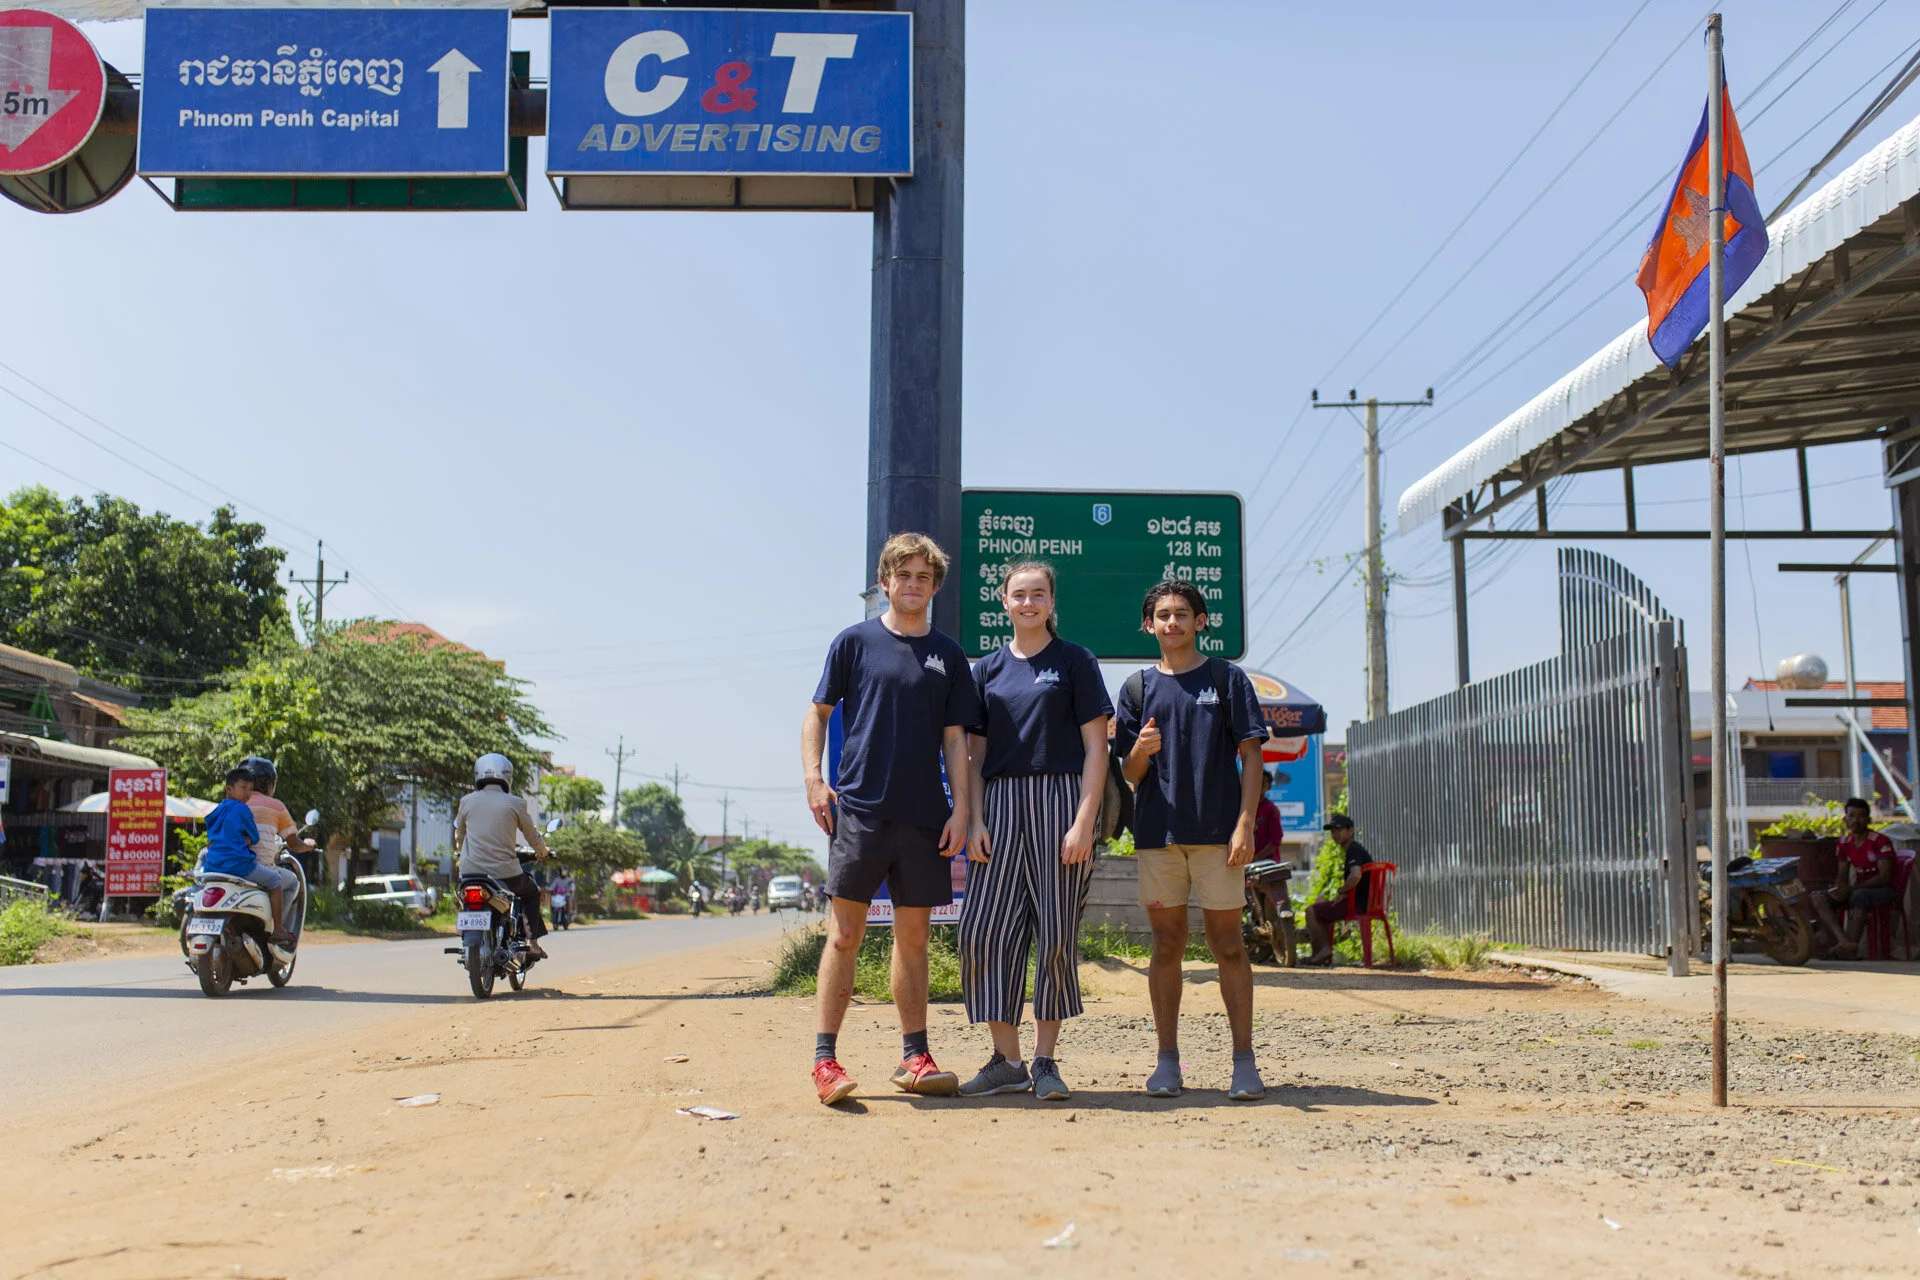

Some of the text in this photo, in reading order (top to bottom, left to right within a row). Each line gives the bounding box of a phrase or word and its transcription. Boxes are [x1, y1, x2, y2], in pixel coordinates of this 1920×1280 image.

[178, 44, 404, 97] រាជធានីភ្នំពេញ
[603, 29, 858, 117] C & T
[178, 109, 399, 131] Phnom Penh Capital
[576, 123, 882, 153] ADVERTISING
[978, 508, 1034, 537] ភ្នំពេញ
[1097, 506, 1108, 521] 6
[1146, 515, 1192, 535] ១២៨
[978, 538, 1083, 556] PHNOM PENH
[1166, 540, 1222, 557] 128 Km
[1197, 584, 1223, 600] Km
[1198, 635, 1224, 651] Km
[1261, 706, 1303, 727] Tiger
